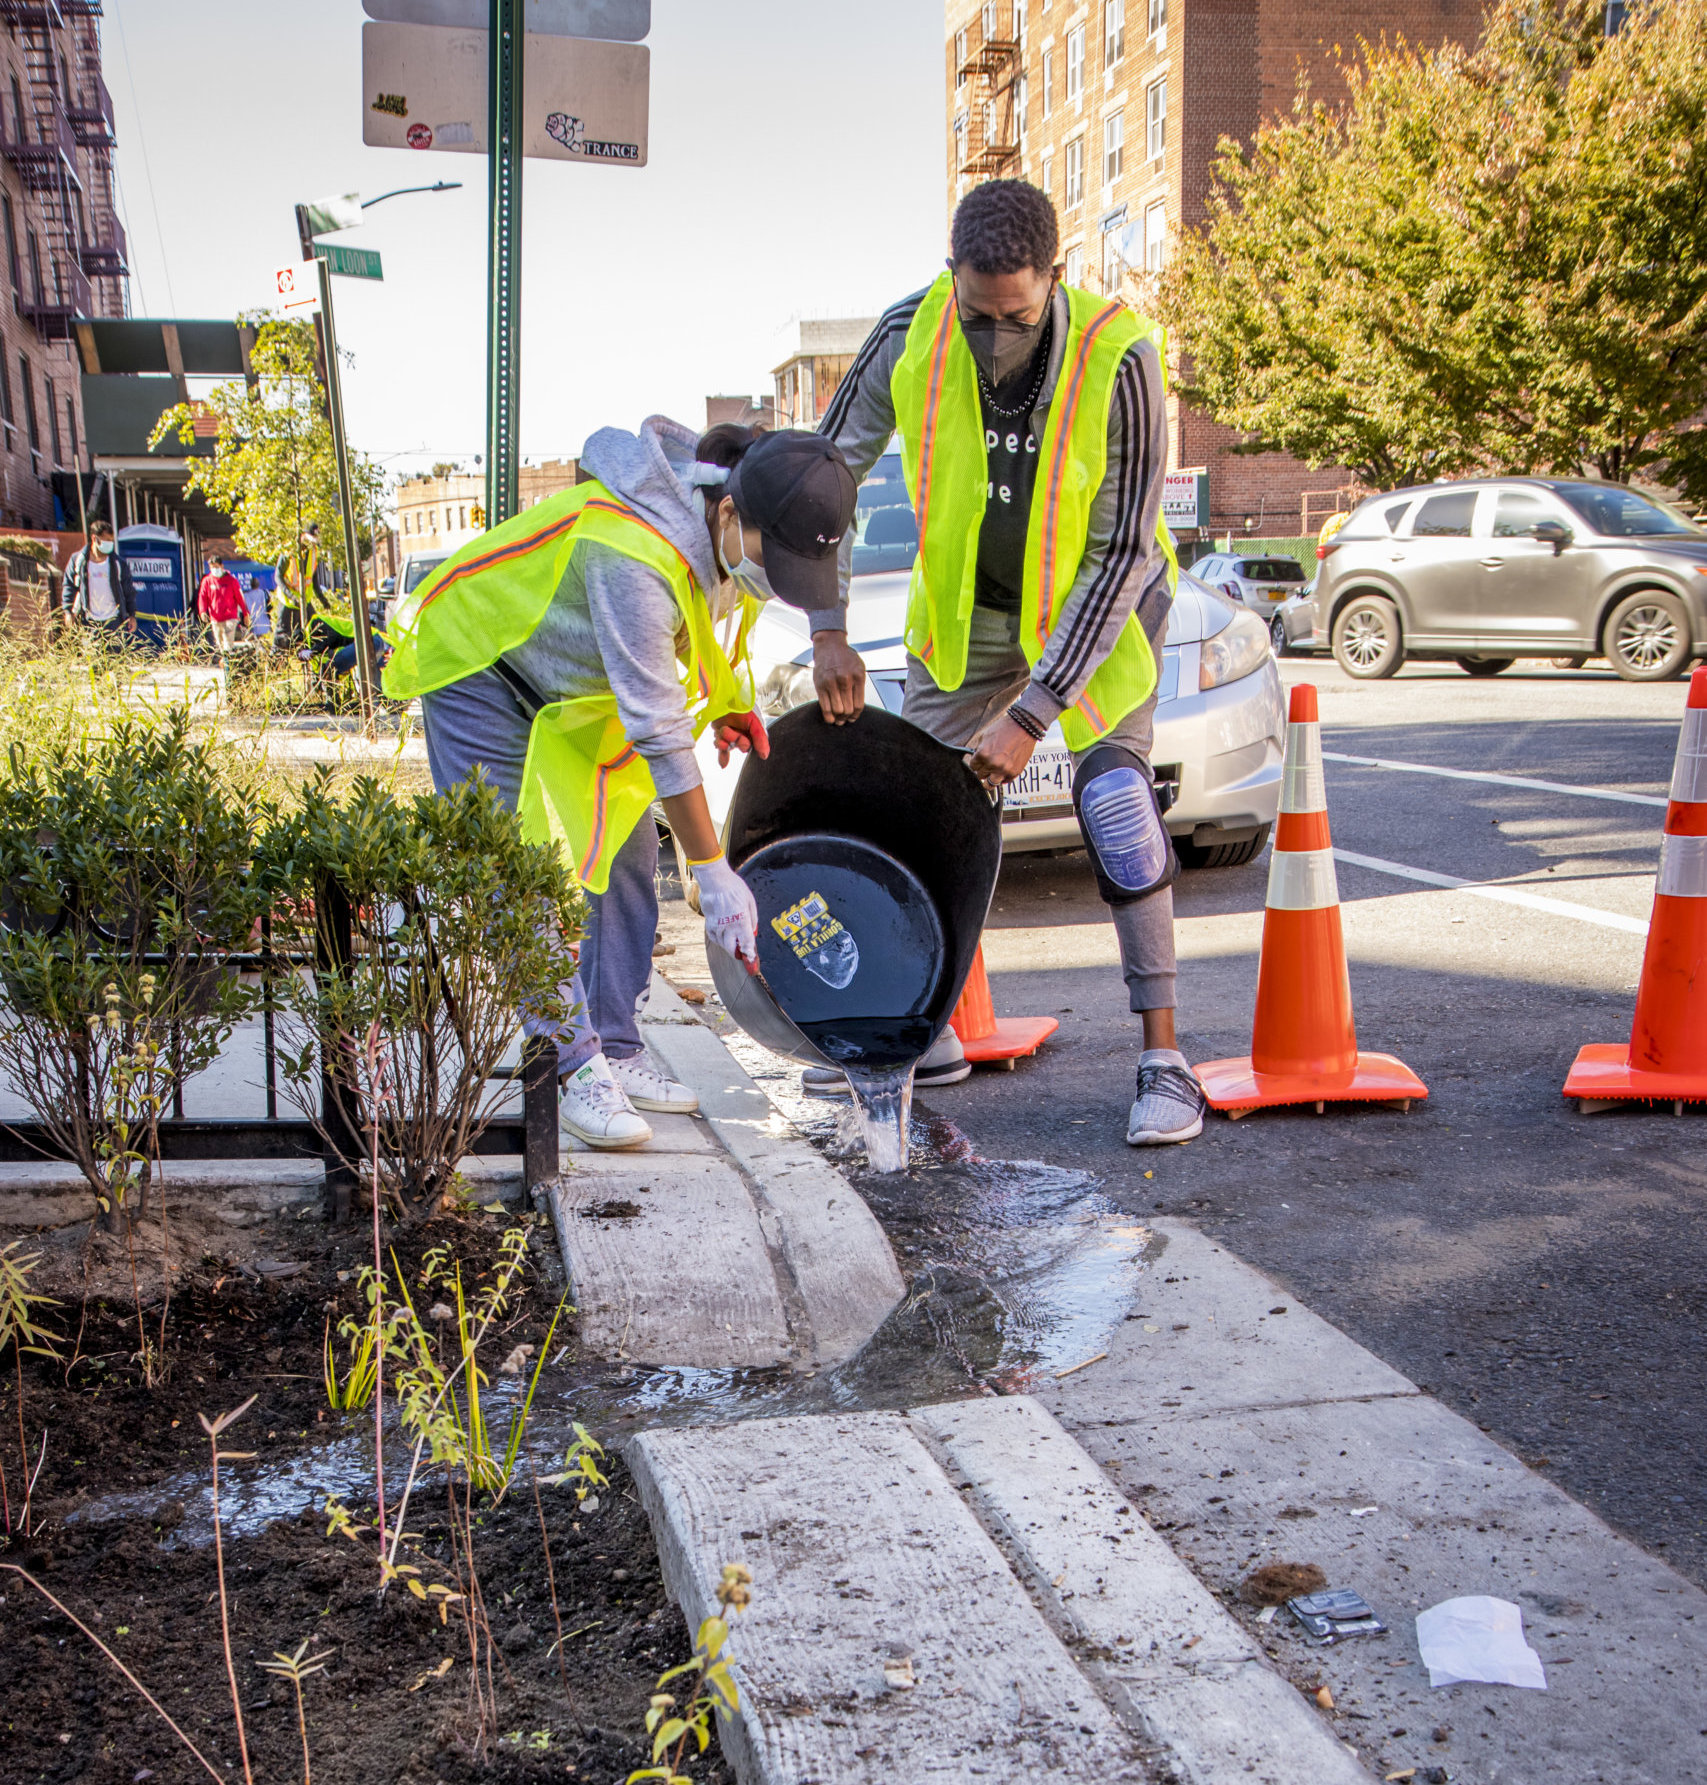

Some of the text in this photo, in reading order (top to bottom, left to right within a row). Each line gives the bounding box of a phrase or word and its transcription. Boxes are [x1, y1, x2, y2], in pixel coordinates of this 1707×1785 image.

[583, 142, 638, 159] TRANCE
[341, 250, 368, 275] LOON
[1166, 476, 1193, 485] NGER
[1051, 752, 1071, 762] YOR
[810, 920, 844, 948] GORILLA
